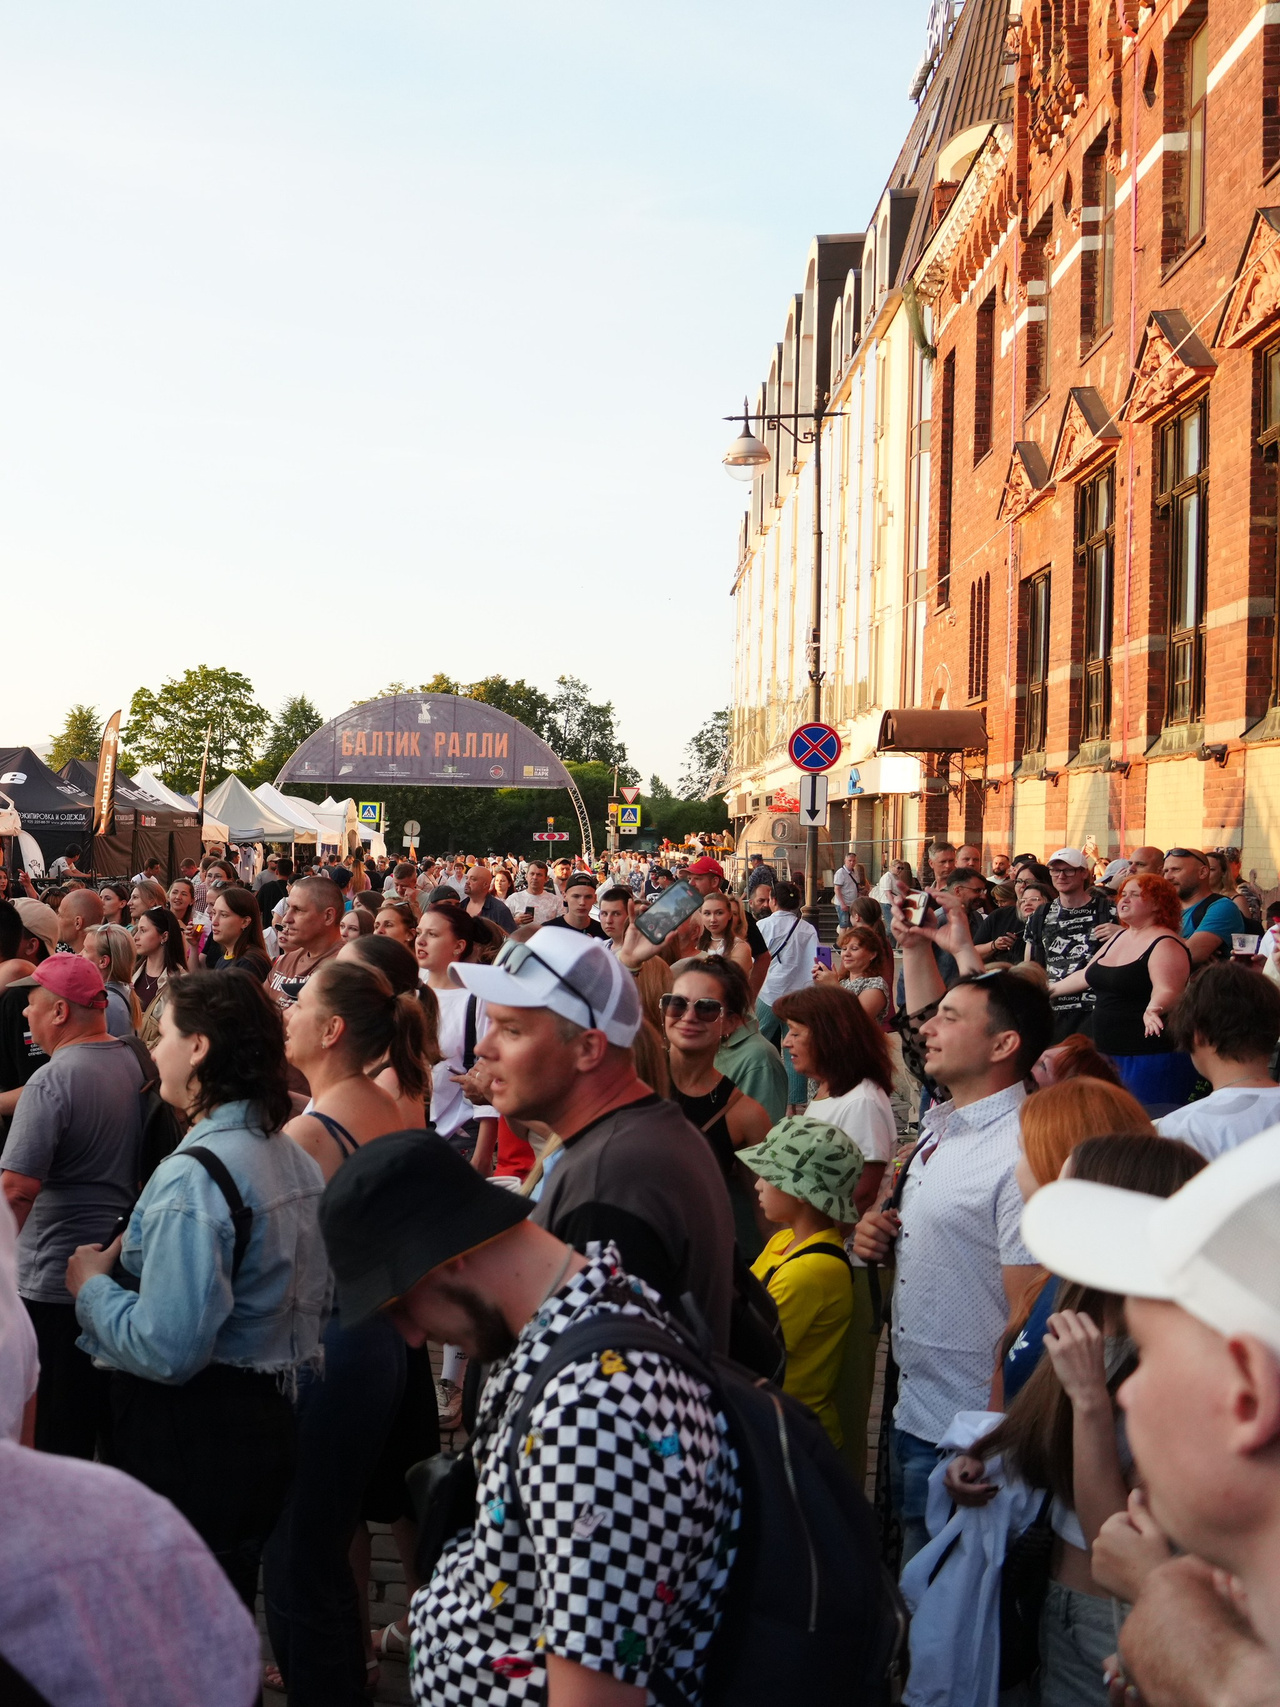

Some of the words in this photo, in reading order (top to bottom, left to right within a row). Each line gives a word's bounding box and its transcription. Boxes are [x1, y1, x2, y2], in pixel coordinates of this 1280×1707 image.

[342, 731, 420, 757] БАЛТИК
[435, 732, 508, 758] РАЛЛИ
[60, 813, 86, 821] ОДЕЖДА
